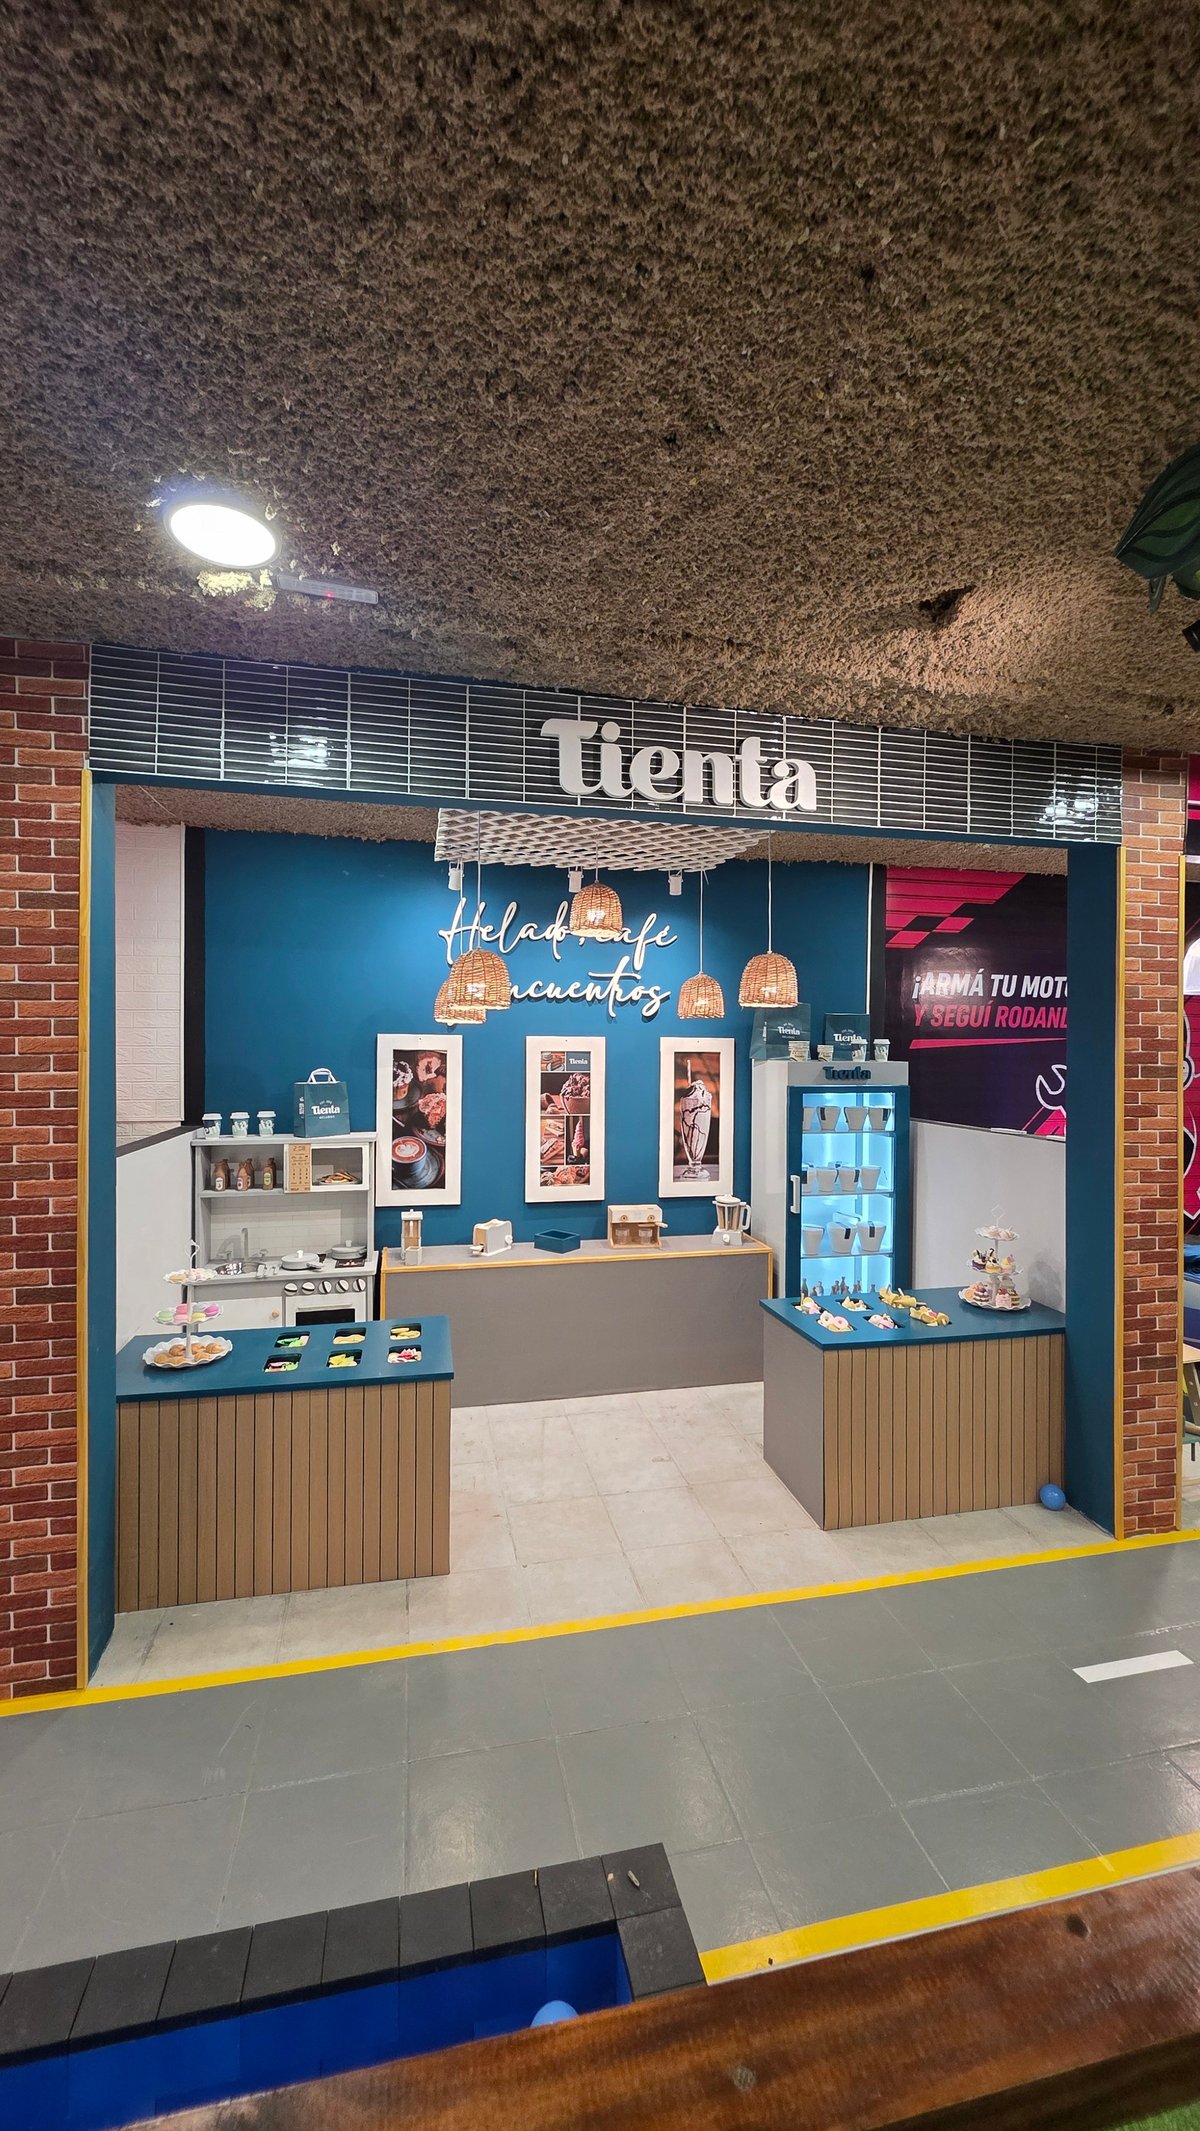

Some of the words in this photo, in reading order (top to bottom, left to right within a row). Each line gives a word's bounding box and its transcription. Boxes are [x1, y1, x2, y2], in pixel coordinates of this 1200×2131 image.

[540, 718, 817, 812] Tienta
[510, 956, 670, 1017] ncuentros
[912, 968, 985, 999] ¡ARMÁ
[991, 974, 1017, 998] TU
[1020, 975, 1068, 999] MOT
[914, 1003, 927, 1027] Y
[930, 1000, 994, 1028] SEGUÍ
[823, 1066, 872, 1081] Tienta
